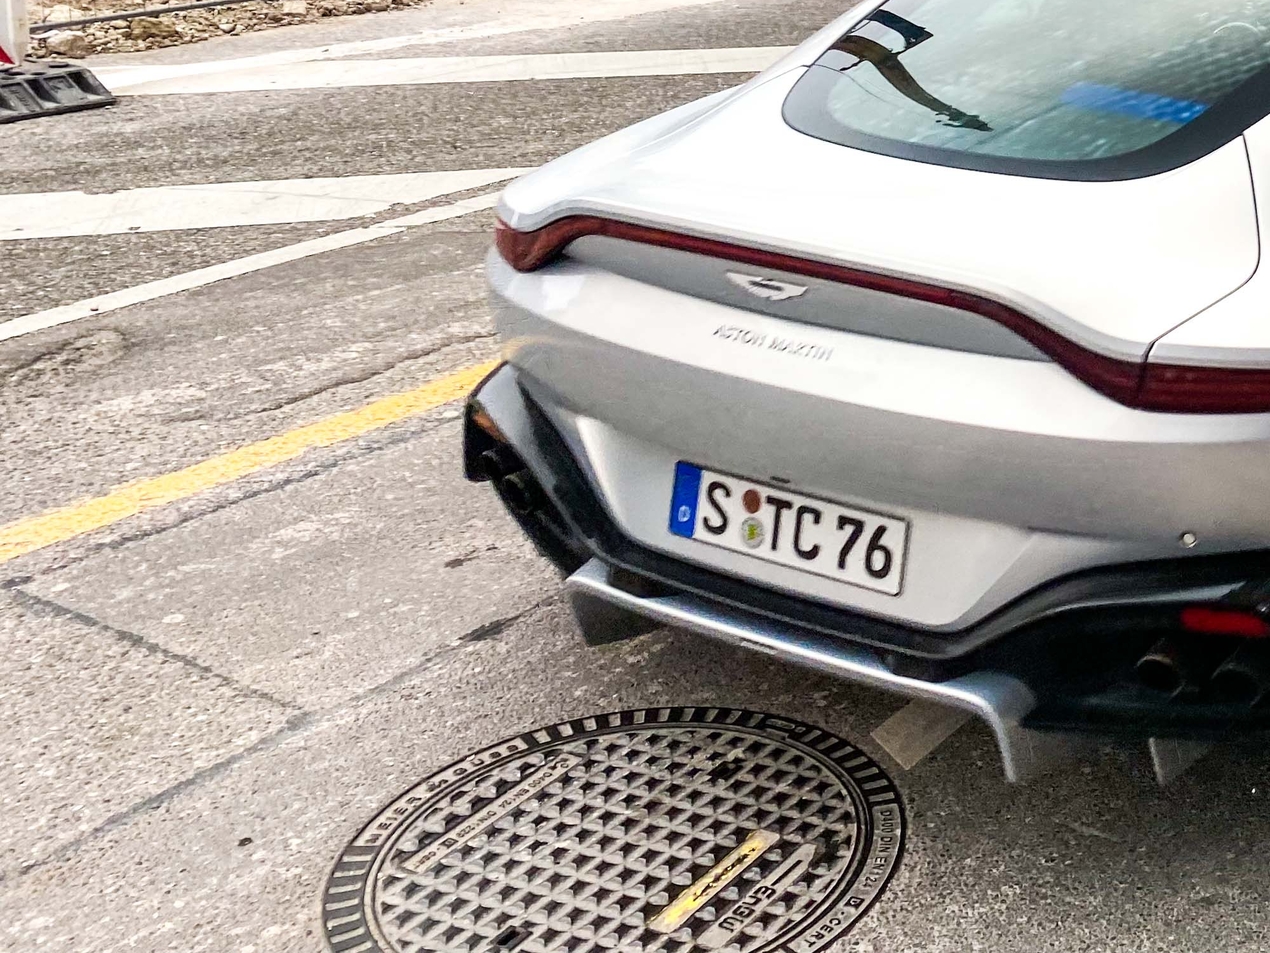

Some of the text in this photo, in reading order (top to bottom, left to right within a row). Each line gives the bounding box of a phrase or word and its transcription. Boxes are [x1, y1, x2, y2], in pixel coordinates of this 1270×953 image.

[713, 324, 835, 362] ASTON MARTIN
[703, 481, 893, 580] S TC 76
